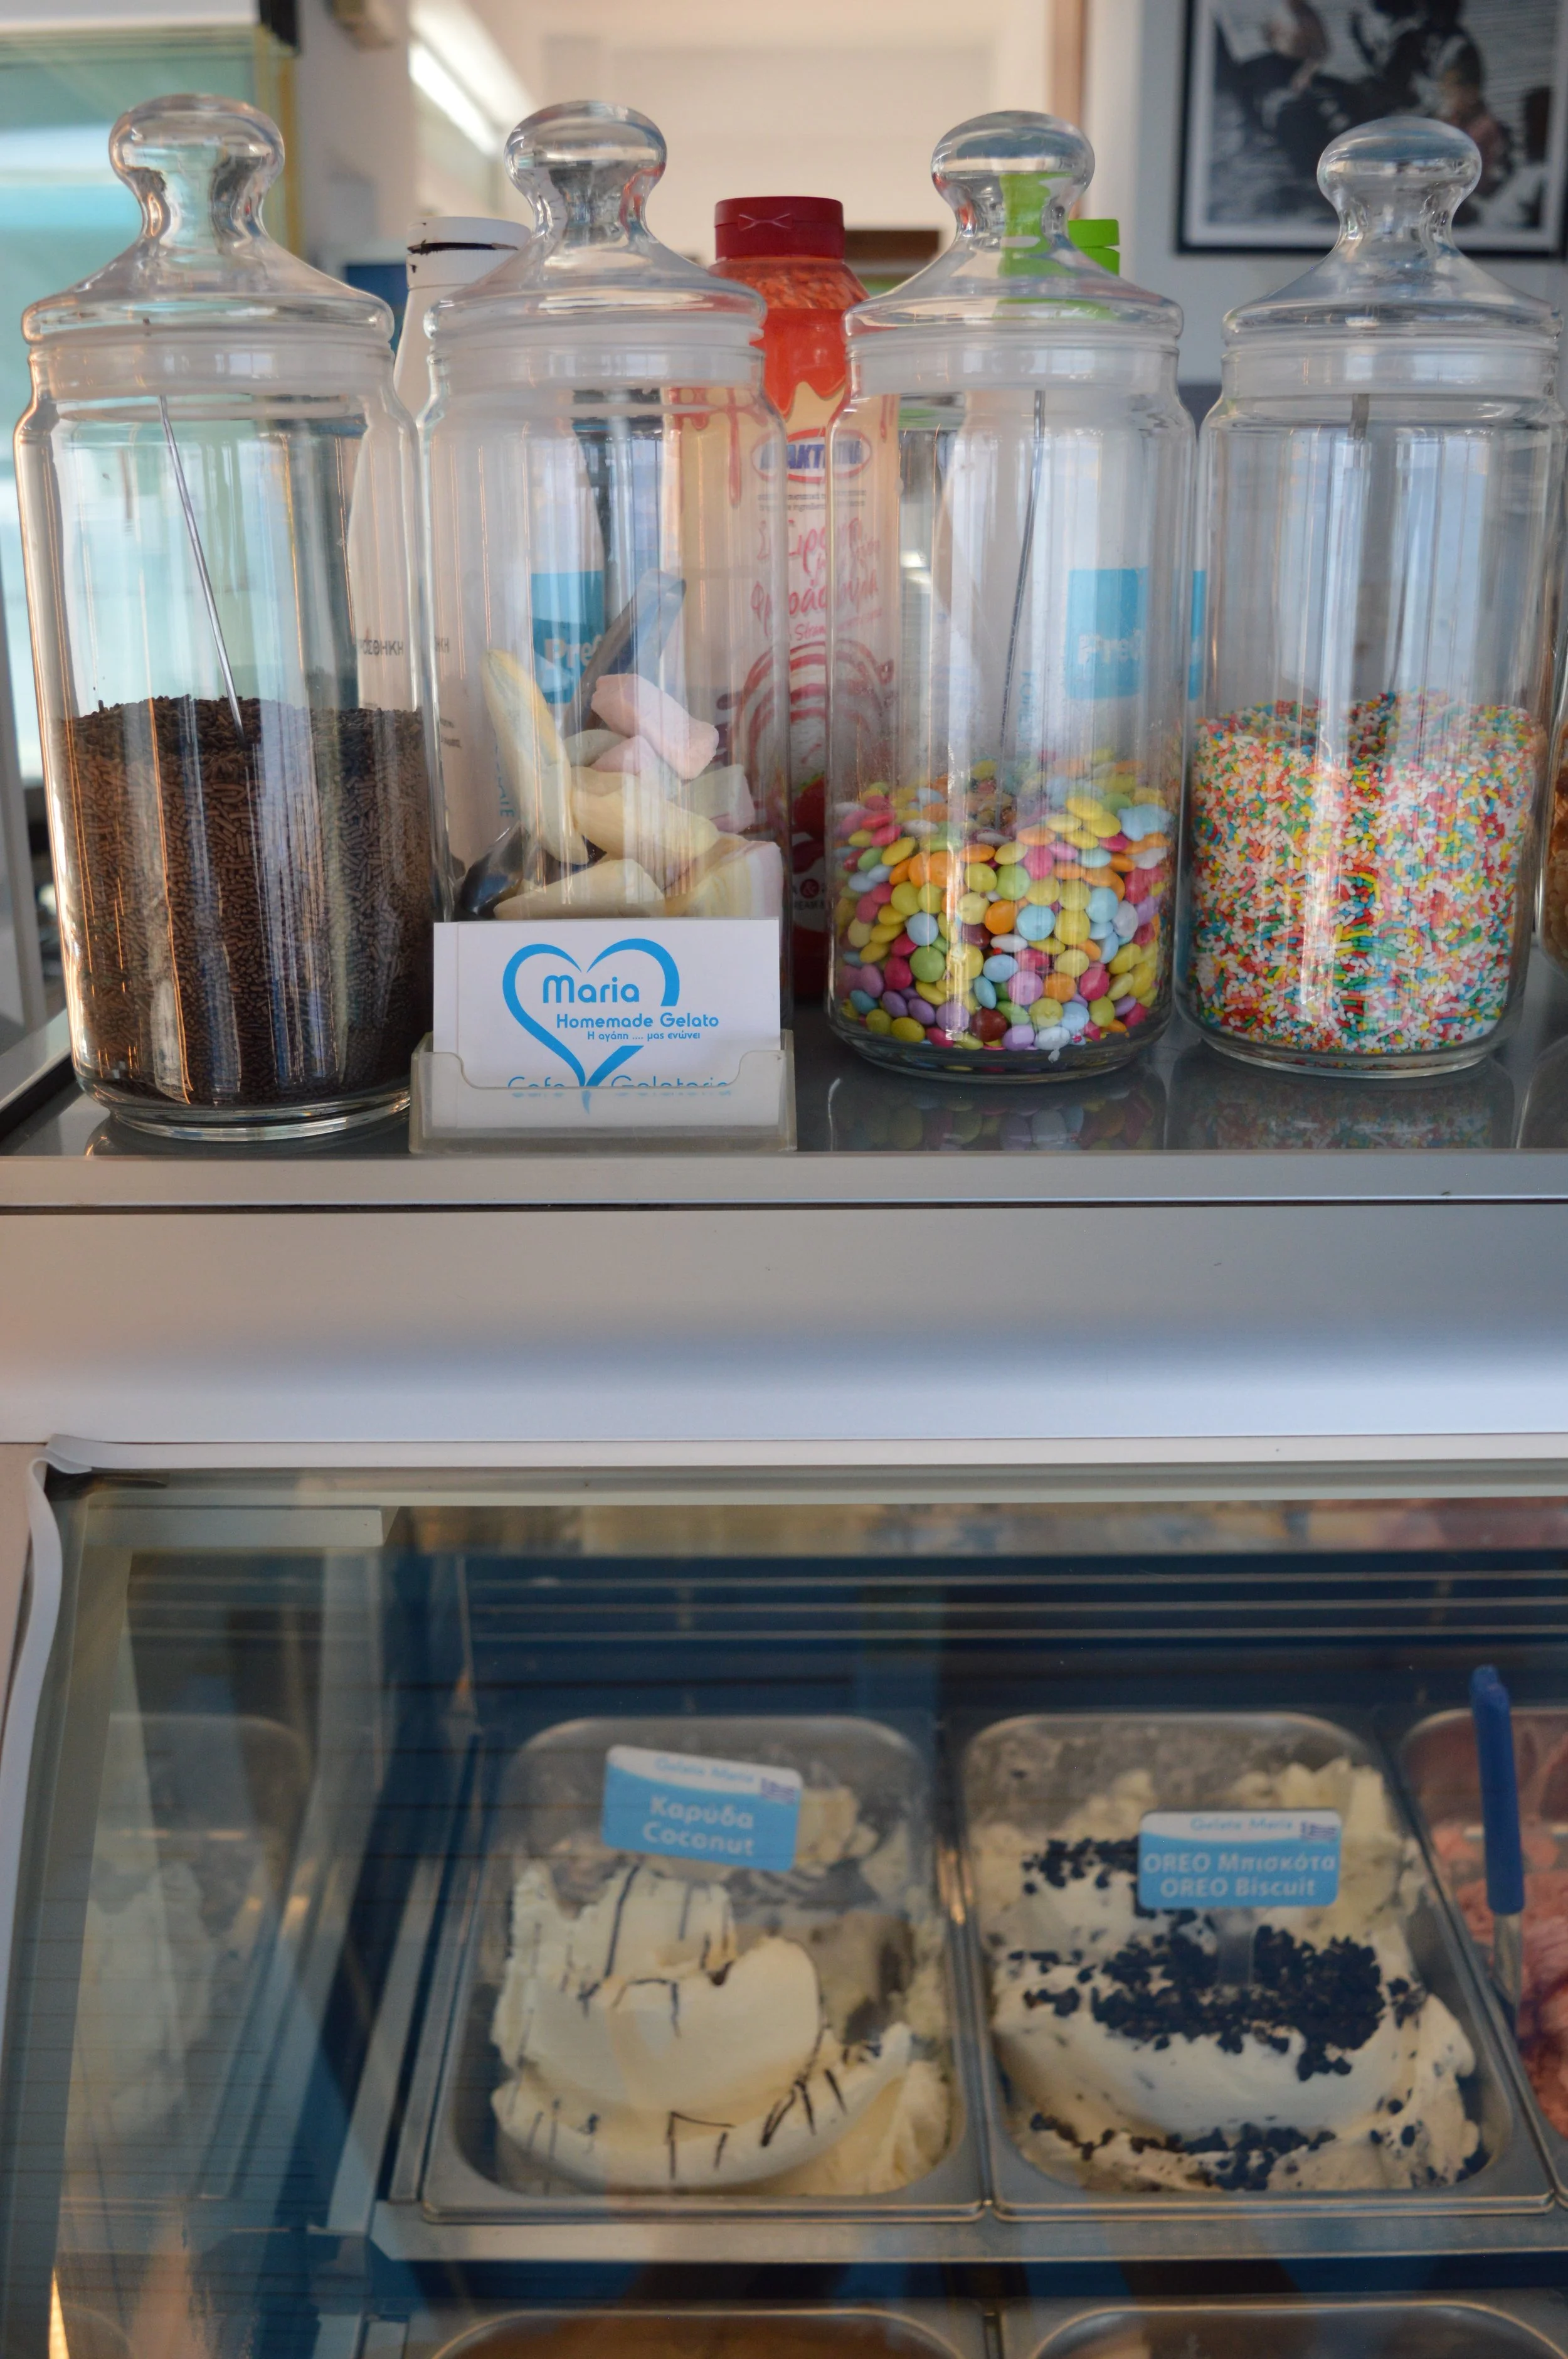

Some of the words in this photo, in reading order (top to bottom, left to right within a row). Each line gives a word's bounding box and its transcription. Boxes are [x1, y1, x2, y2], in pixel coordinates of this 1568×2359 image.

[543, 974, 640, 1003] Maria
[556, 1013, 654, 1028] Homemade
[660, 1012, 719, 1028] Gelato
[647, 1032, 664, 1041] μας
[667, 1030, 701, 1040] ενώνει
[650, 1794, 753, 1829] Καρύδα
[642, 1821, 755, 1856] Coconut
[1143, 1853, 1211, 1873] OREO
[1217, 1851, 1335, 1873] Μπισκότα
[1161, 1878, 1228, 1898] OREO
[1235, 1877, 1315, 1897] Biscuit
